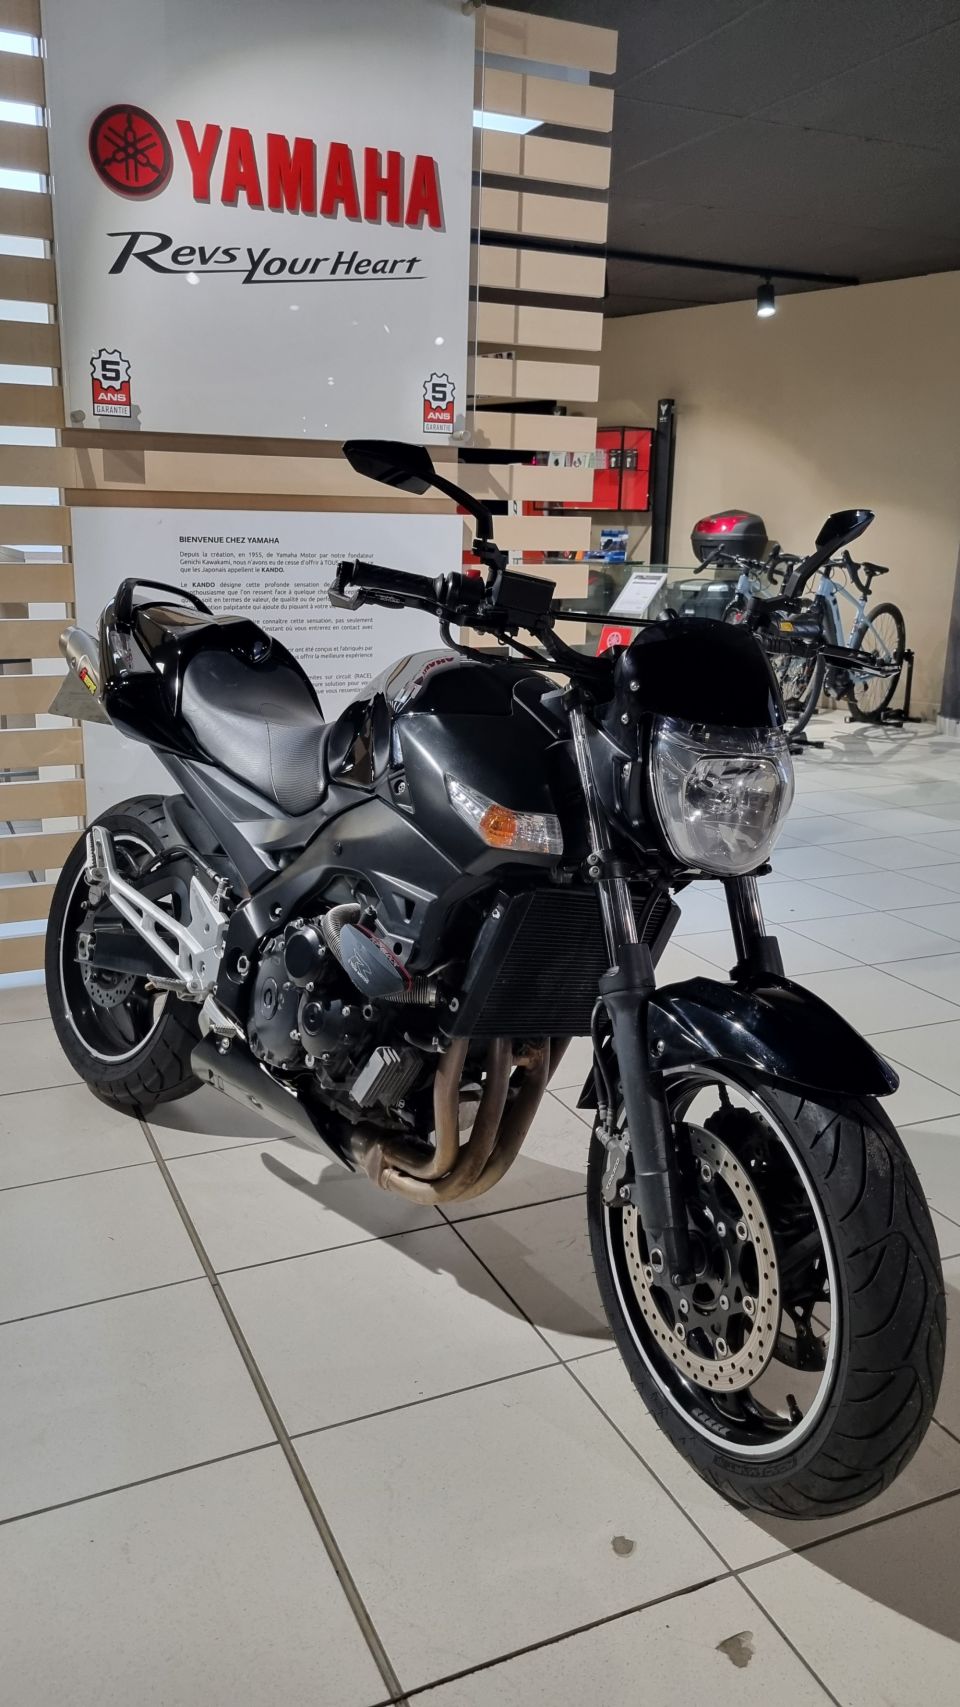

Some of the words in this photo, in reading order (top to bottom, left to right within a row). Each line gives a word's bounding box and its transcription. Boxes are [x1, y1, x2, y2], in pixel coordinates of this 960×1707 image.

[176, 119, 444, 231] YAMAHA
[106, 231, 241, 275] Revs
[242, 247, 329, 284] Your
[329, 250, 422, 276] Heart
[101, 360, 120, 381] 5
[98, 393, 126, 402] ANS
[432, 383, 447, 401] 5
[96, 405, 128, 414] GARANTIE
[427, 412, 450, 420] ANS
[226, 536, 246, 544] CHEZ
